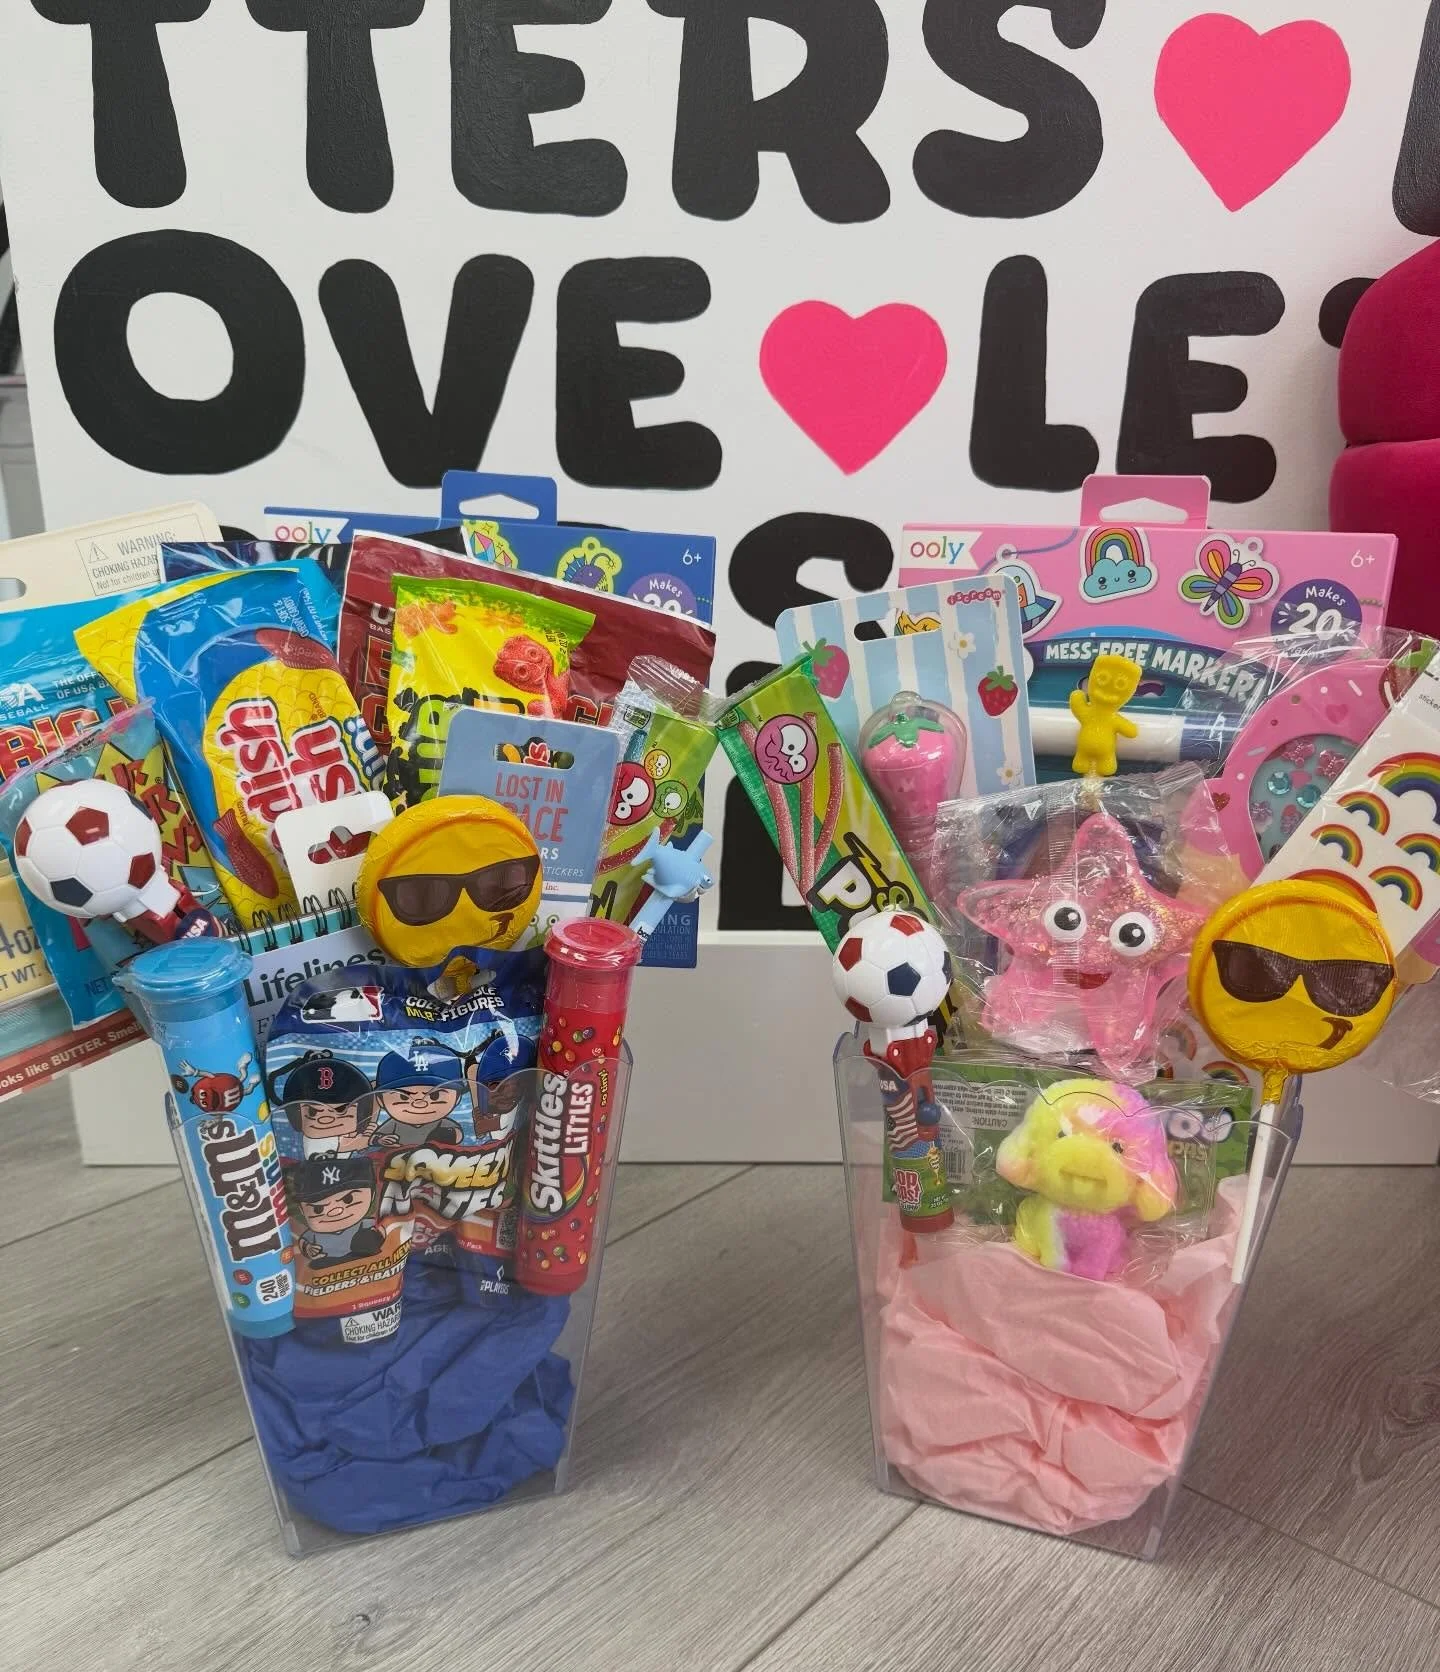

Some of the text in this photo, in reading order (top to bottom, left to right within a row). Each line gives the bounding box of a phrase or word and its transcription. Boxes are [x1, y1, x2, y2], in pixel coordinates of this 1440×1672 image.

[54, 229, 723, 490] OVE
[682, 549, 702, 566] 6+
[910, 535, 965, 565] ooly
[1350, 551, 1376, 568] 6+
[92, 560, 130, 579] CHOKING
[122, 570, 151, 585] children
[649, 578, 683, 598] Makes
[1305, 586, 1346, 606] Makes
[1288, 602, 1343, 640] 20
[1046, 641, 1149, 667] MESS-FREE
[54, 678, 74, 689] THE
[56, 689, 71, 700] OF
[73, 683, 96, 696] USA
[307, 692, 328, 719] BRAND
[495, 772, 565, 804] LOST IN
[543, 866, 585, 877] TICKERS
[12, 963, 42, 984] WT.
[243, 948, 386, 1008] Lifelines
[84, 976, 108, 995] NET
[406, 996, 505, 1022] MLB FIGURES
[26, 1059, 50, 1078] like
[51, 1037, 107, 1067] BUTTER.
[529, 1072, 569, 1214] Skittles
[258, 1130, 291, 1226] minis
[311, 1264, 367, 1287] COLLECT
[367, 1256, 393, 1273] ALL
[260, 1279, 279, 1302] 240
[304, 1277, 357, 1298] FIELDERS
[359, 1274, 371, 1284] &
[344, 1323, 376, 1336] CHOKING
